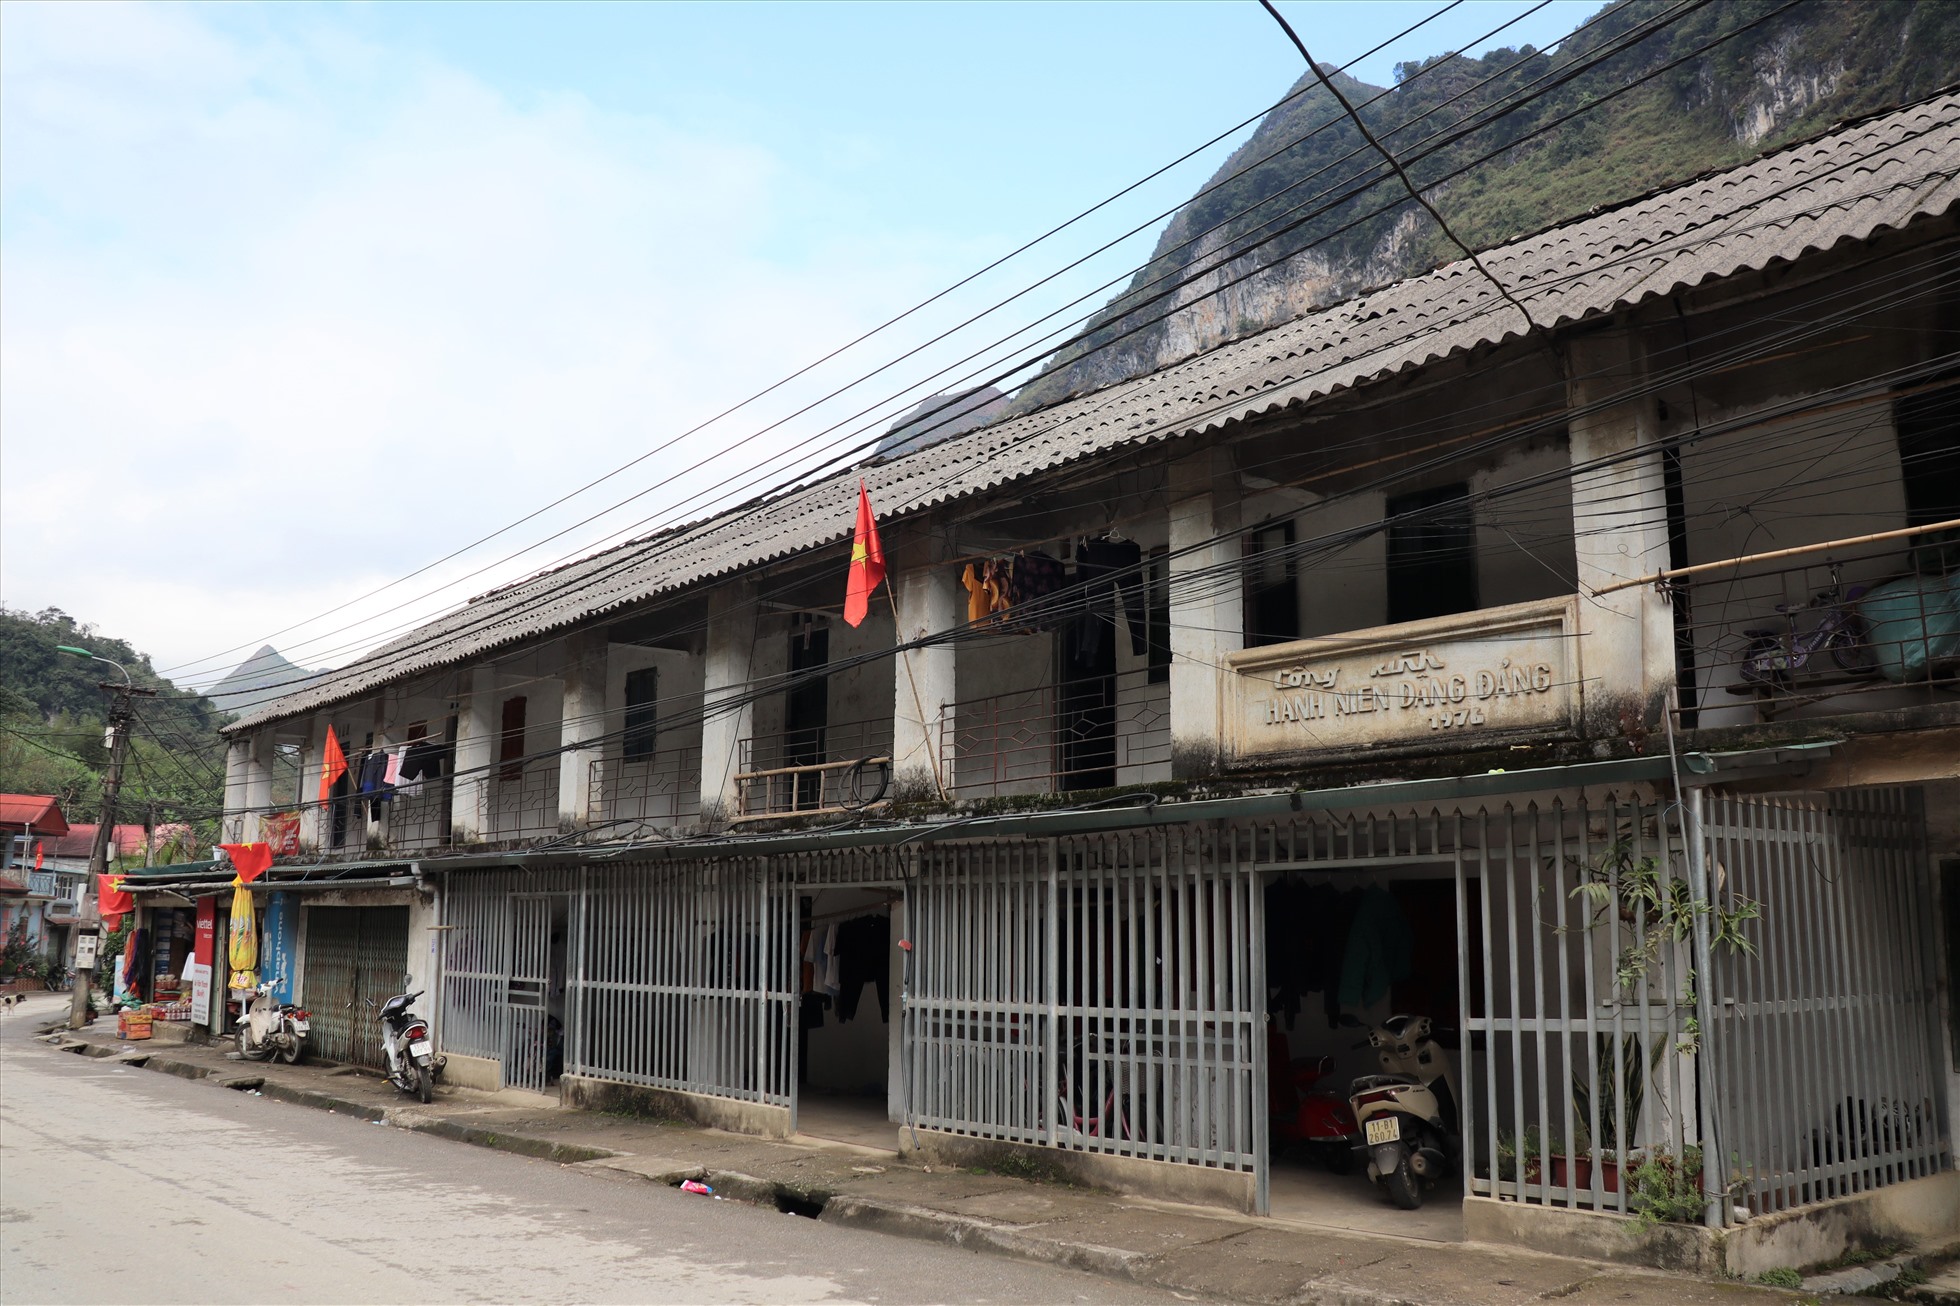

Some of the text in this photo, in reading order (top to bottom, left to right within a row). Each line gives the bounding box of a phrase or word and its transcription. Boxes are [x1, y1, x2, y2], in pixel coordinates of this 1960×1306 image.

[1273, 665, 1341, 690] Công
[1428, 707, 1485, 730] 1976
[1371, 1119, 1394, 1133] 11-B1
[1369, 1129, 1398, 1144] 260.74
